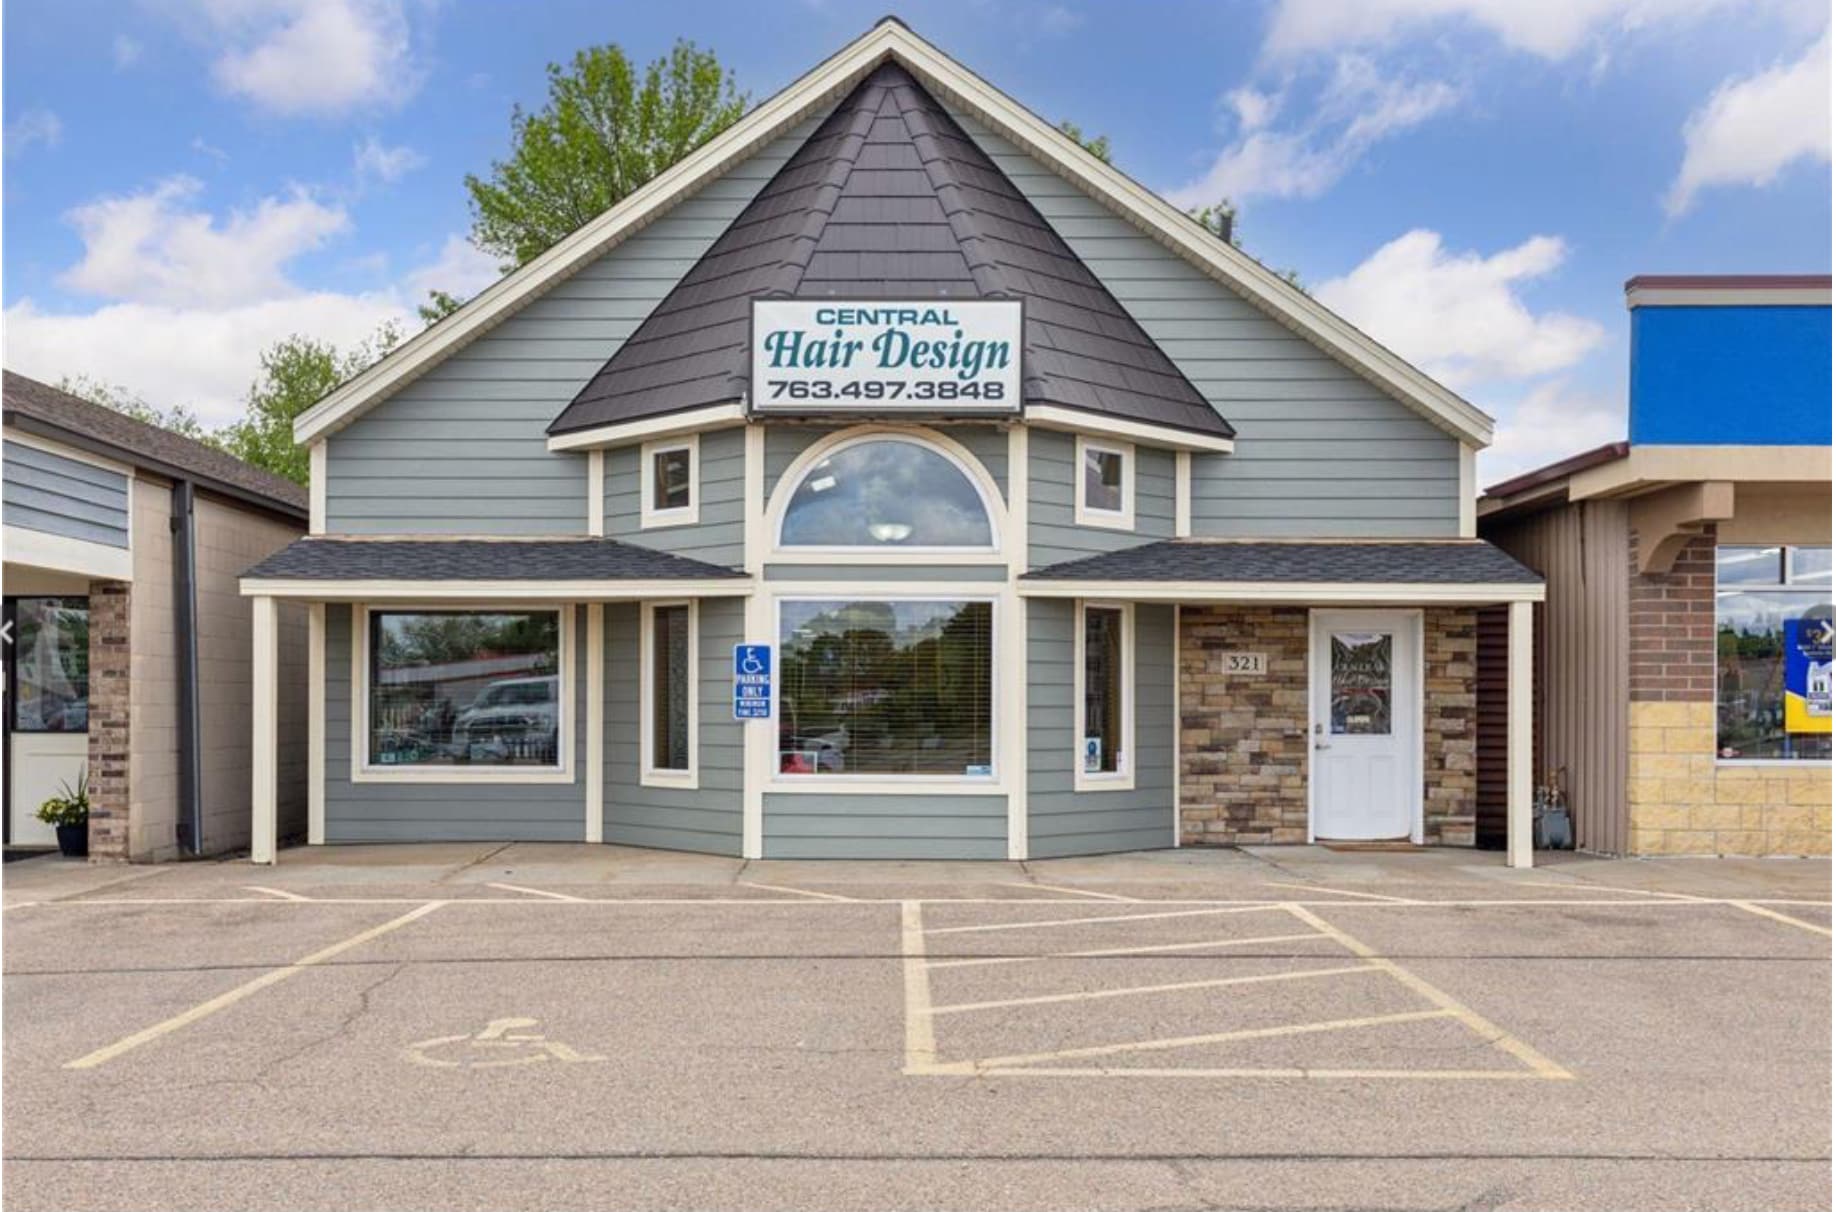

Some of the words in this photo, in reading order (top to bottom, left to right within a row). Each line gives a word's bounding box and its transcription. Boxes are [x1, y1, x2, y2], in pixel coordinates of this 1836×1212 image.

[816, 309, 959, 326] CENTRAL
[764, 329, 864, 368] Hair
[871, 327, 1011, 380] Design
[767, 380, 1005, 400] 763.497.3848
[1229, 656, 1259, 671] 321
[736, 674, 770, 685] PARKING
[742, 686, 763, 697] ONLY
